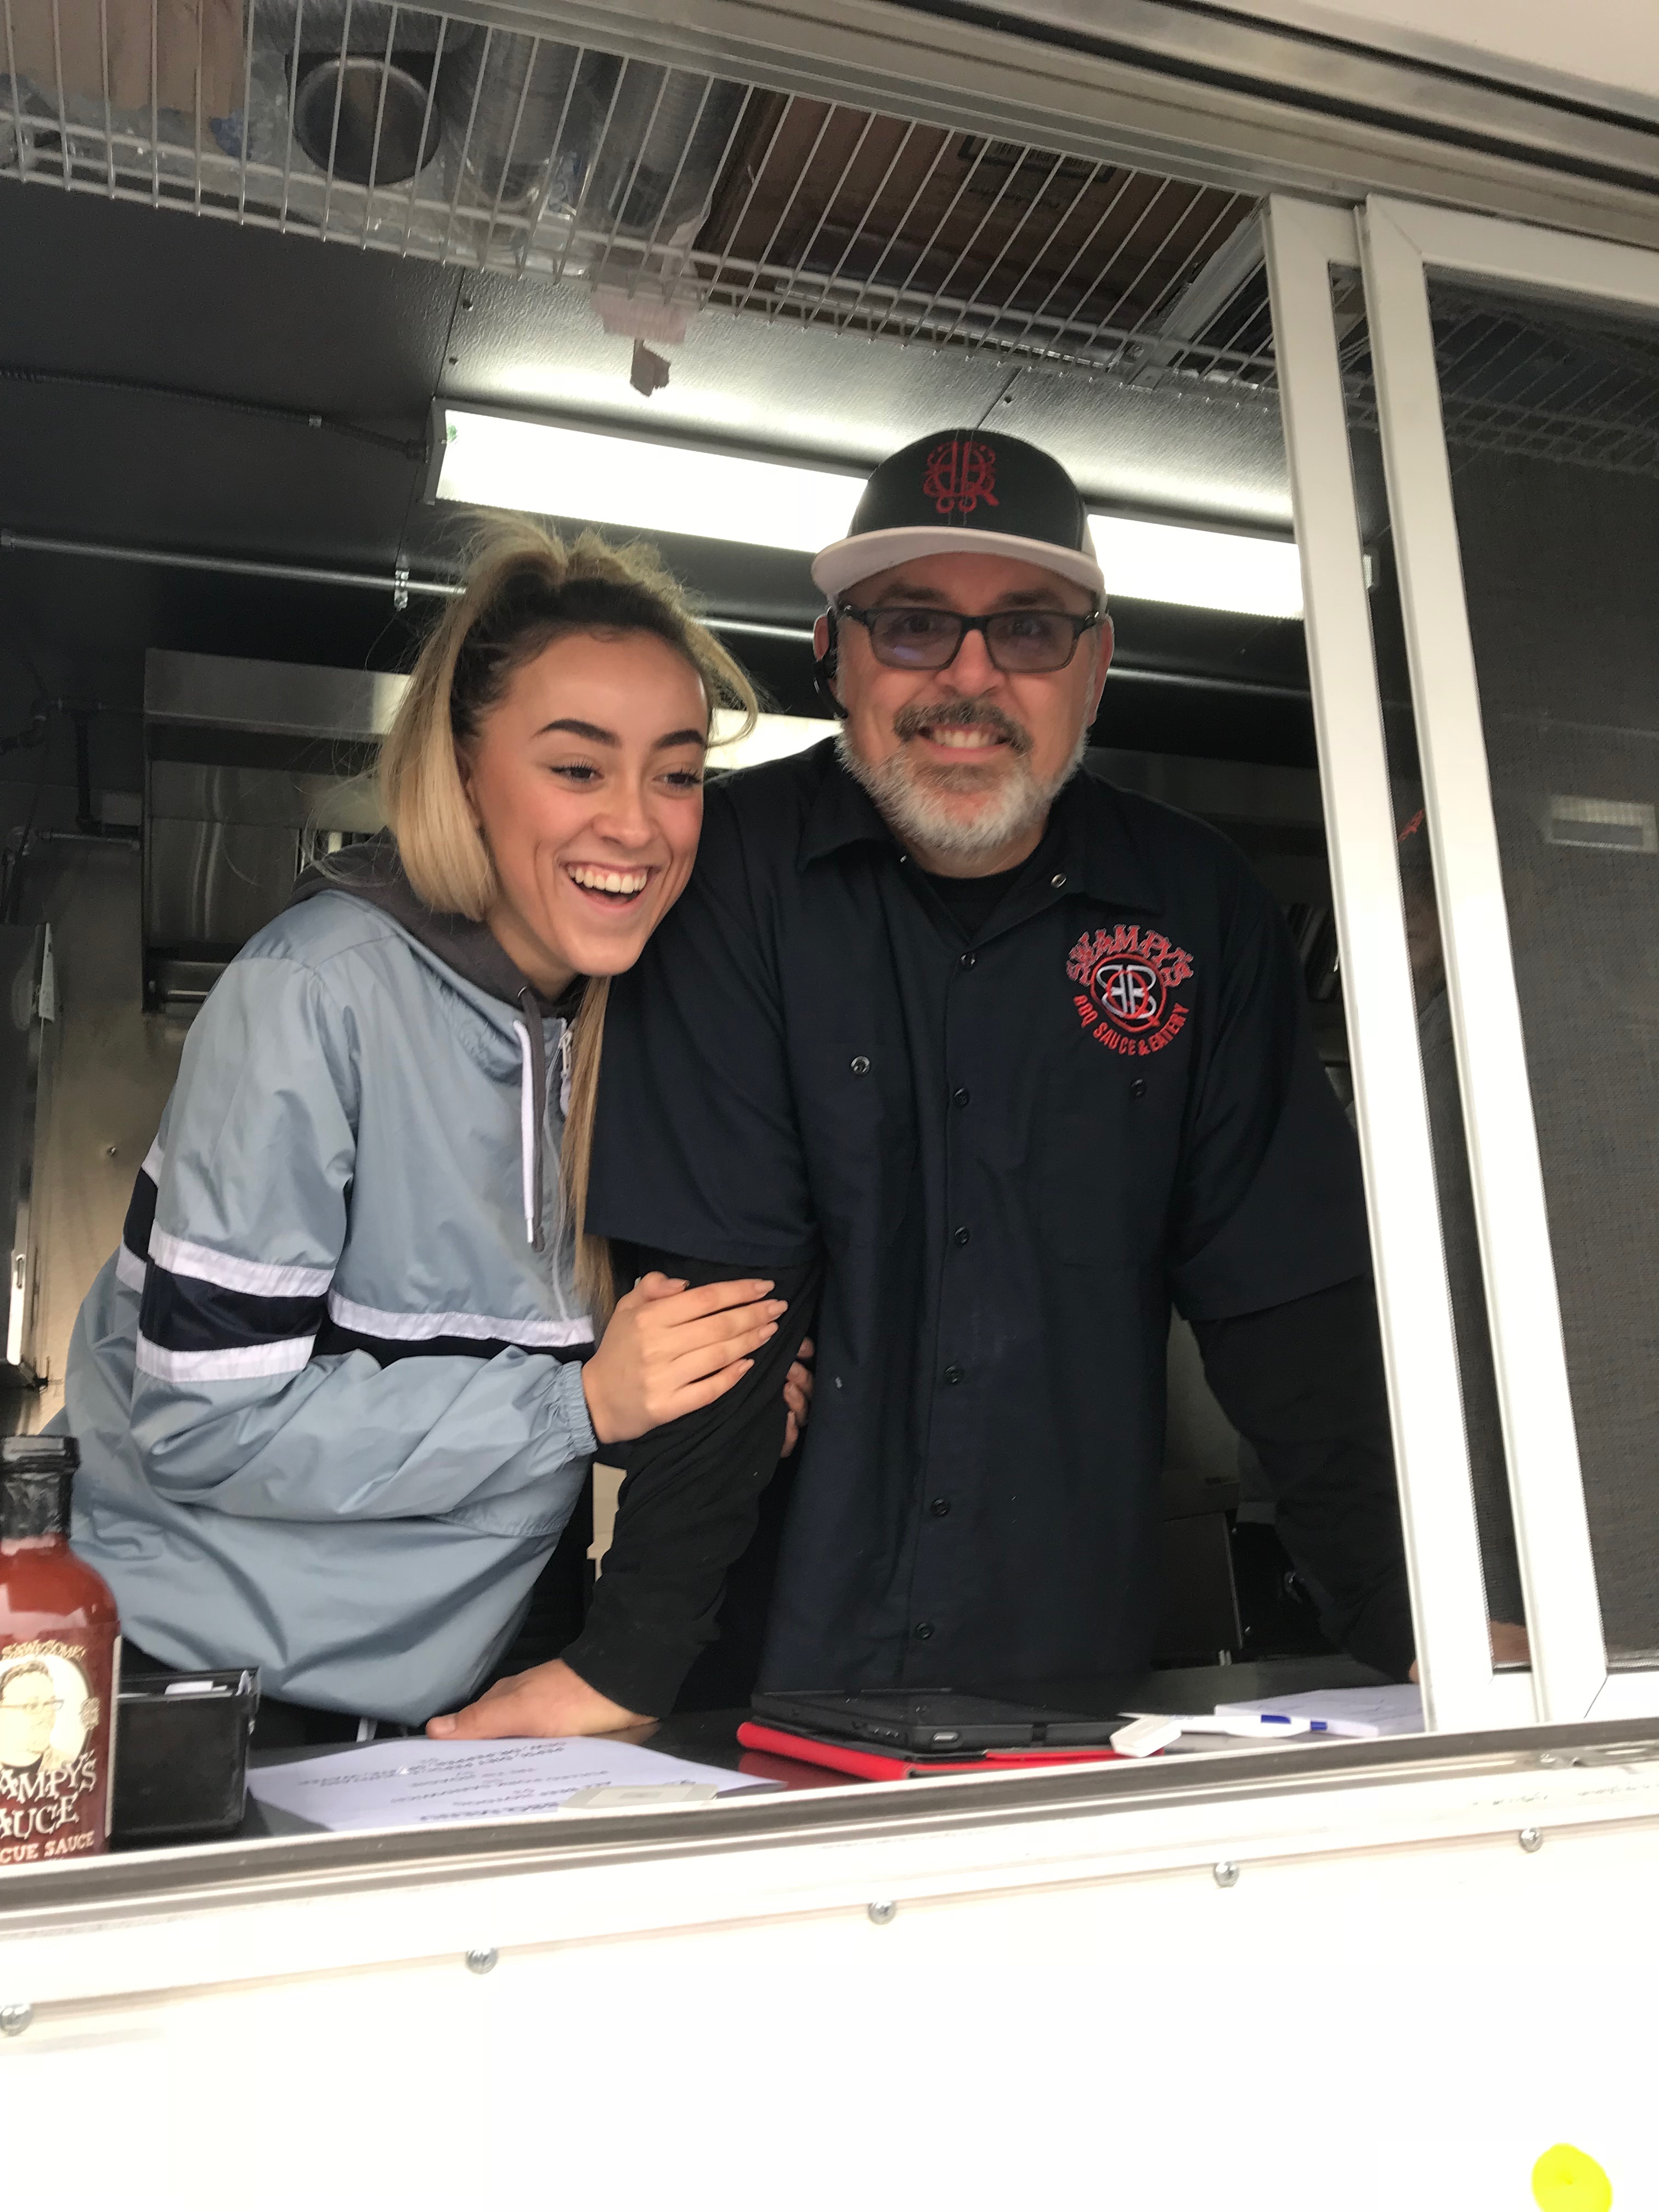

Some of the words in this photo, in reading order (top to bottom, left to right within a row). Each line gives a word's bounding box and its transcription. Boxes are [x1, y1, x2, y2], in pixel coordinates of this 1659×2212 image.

[1093, 1022, 1136, 1056] SAUCE
[0, 1748, 97, 1804] AMPY'S
[44, 1830, 95, 1858] SAUCE
